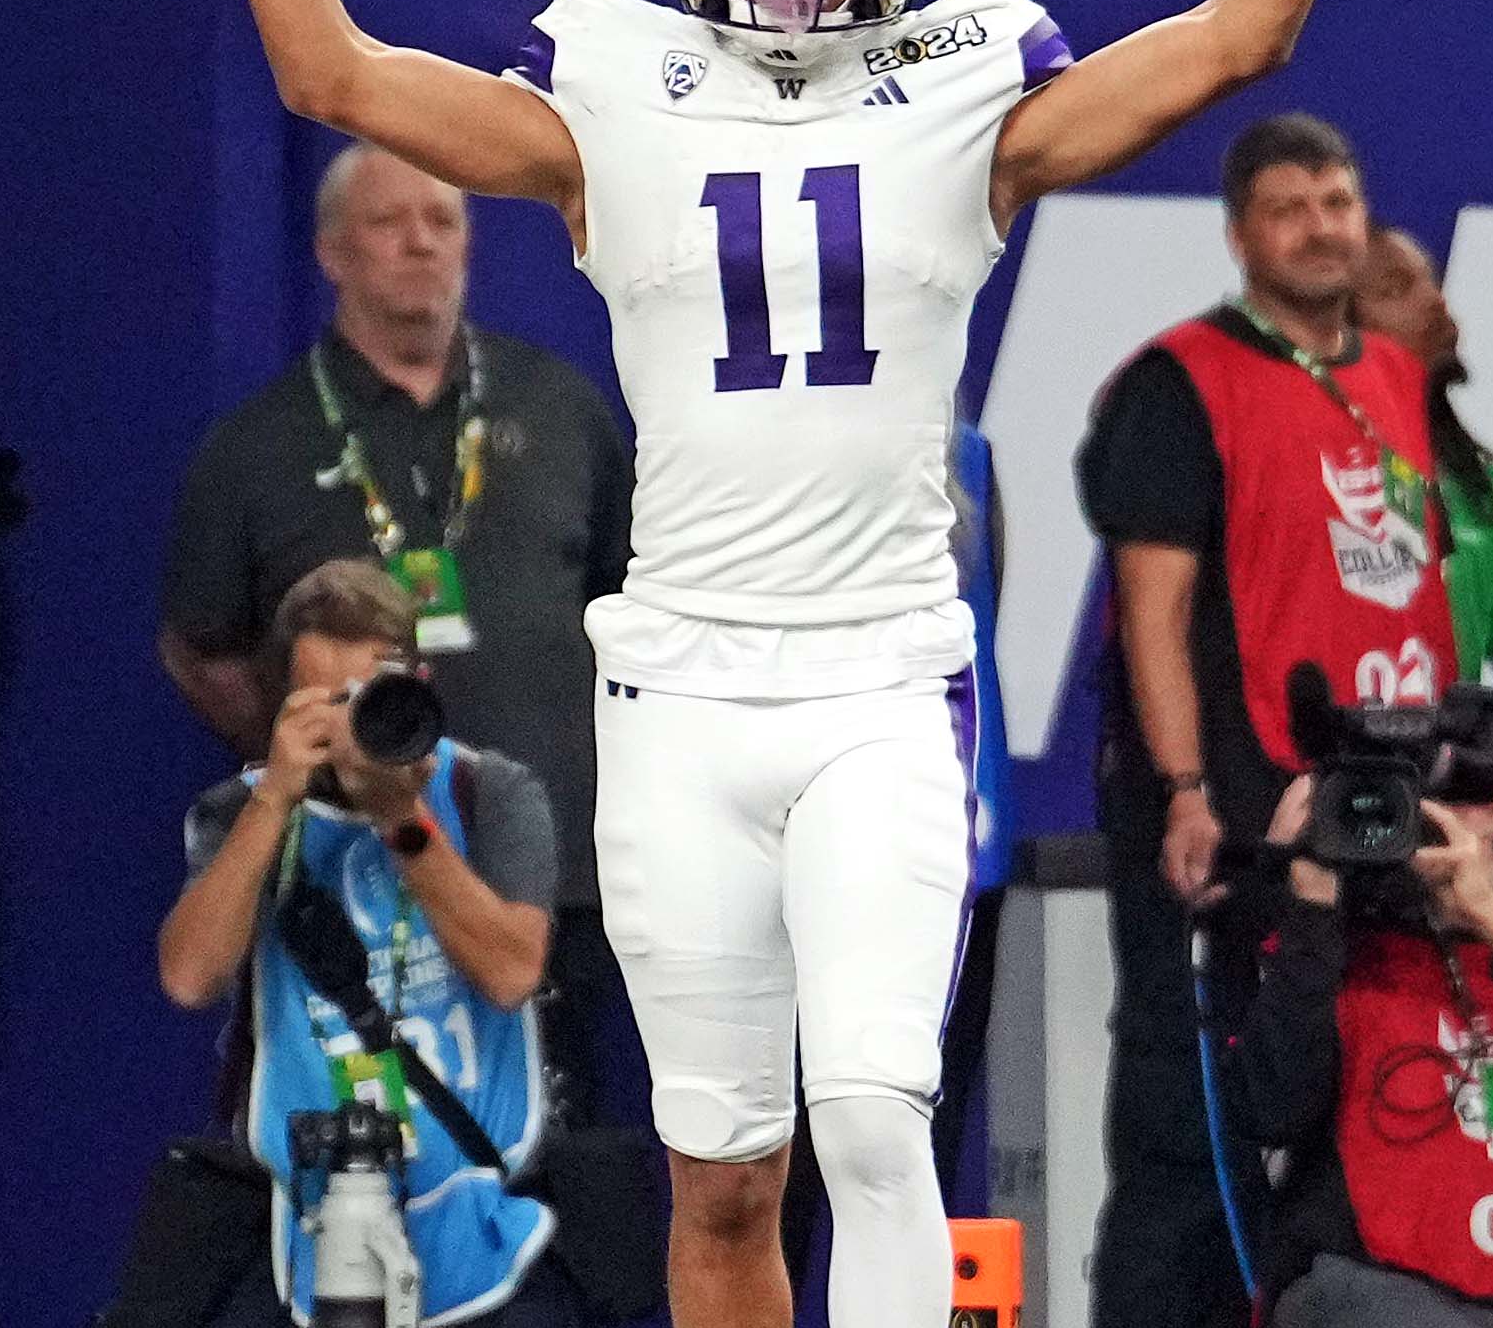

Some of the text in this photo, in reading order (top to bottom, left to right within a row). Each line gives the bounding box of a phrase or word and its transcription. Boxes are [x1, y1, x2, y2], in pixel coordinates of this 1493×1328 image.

[667, 71, 694, 95] 12
[772, 77, 807, 101] W
[699, 163, 880, 394] 11
